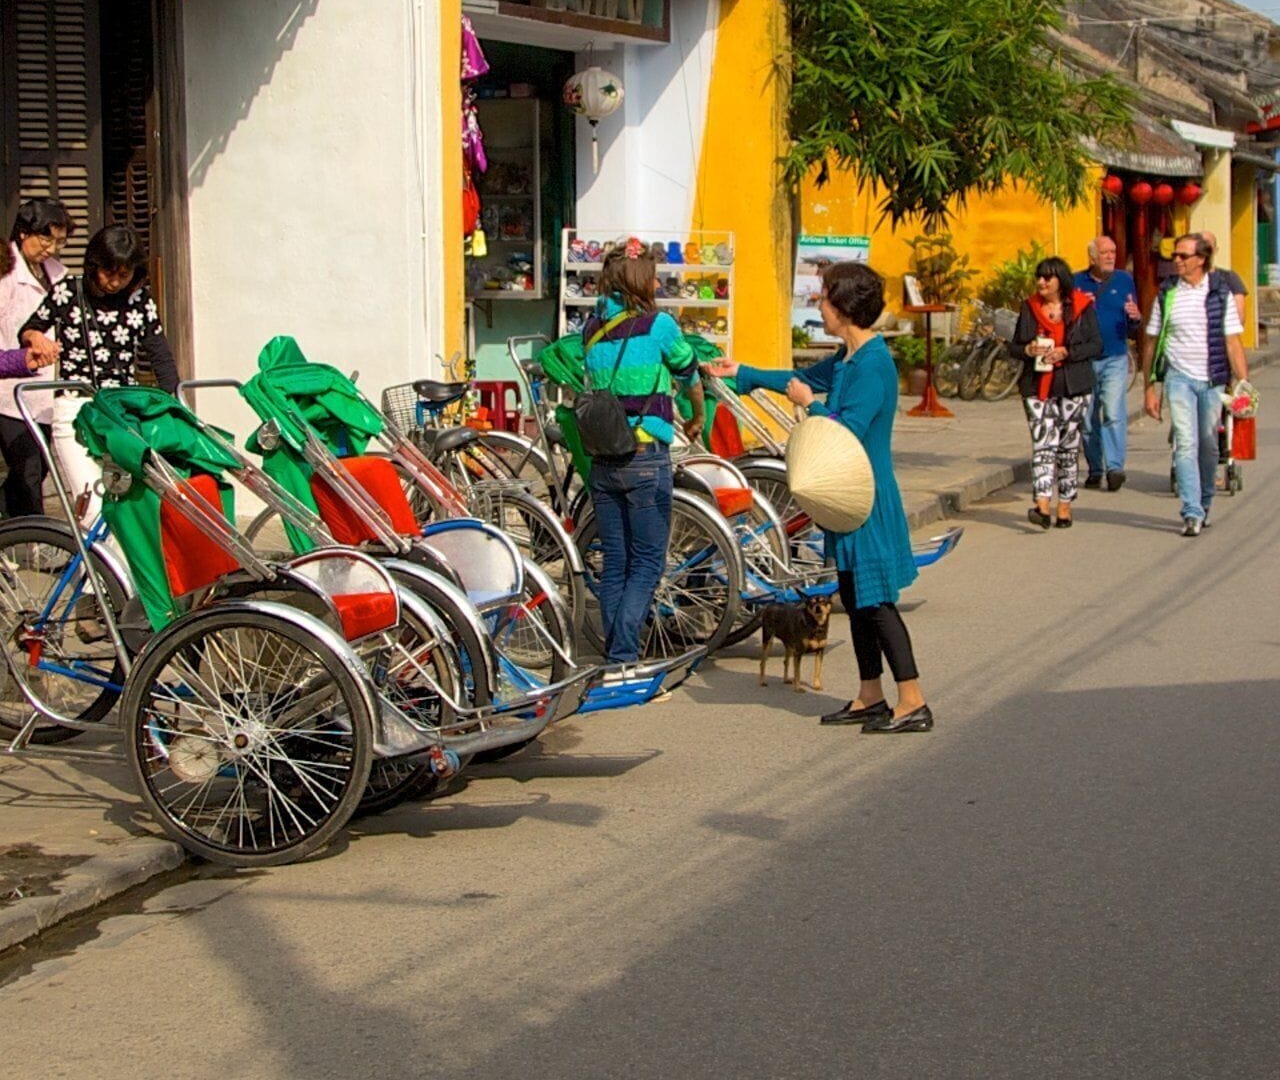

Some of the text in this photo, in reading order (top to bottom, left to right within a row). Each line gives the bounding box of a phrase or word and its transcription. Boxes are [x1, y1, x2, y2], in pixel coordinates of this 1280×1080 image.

[800, 236, 869, 246] Airlines Ticket Office
